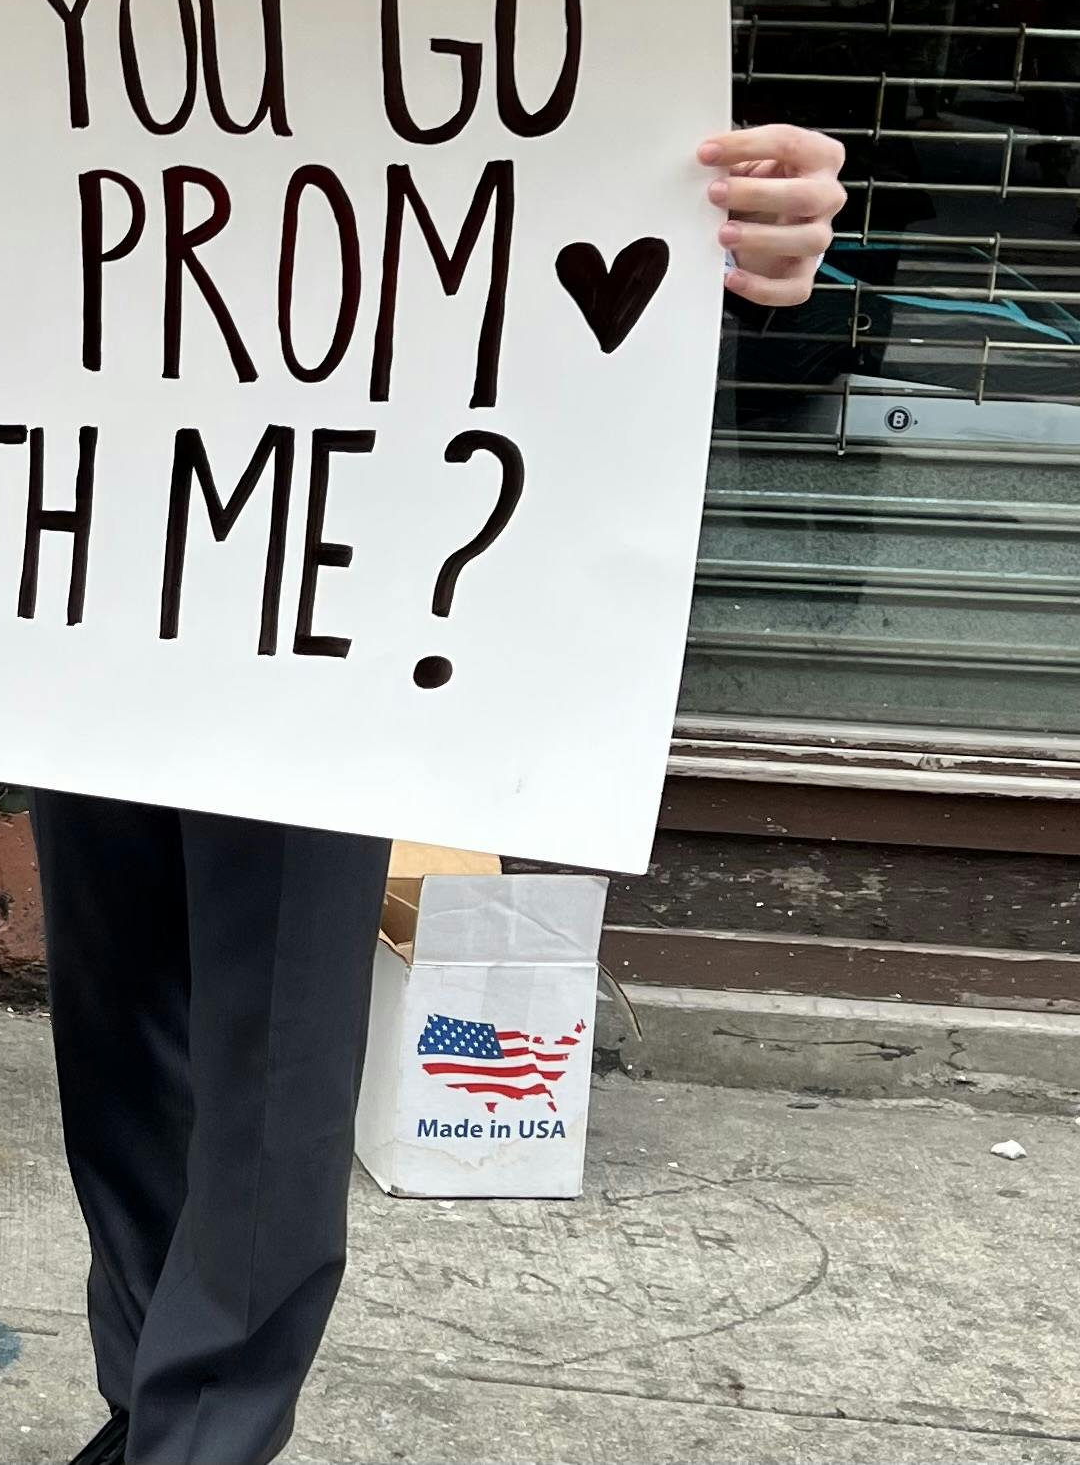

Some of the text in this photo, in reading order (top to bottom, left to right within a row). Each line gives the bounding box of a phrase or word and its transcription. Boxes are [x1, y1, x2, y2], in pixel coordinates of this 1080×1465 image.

[79, 160, 515, 410] PROM
[417, 1118, 566, 1139] Made in USA
